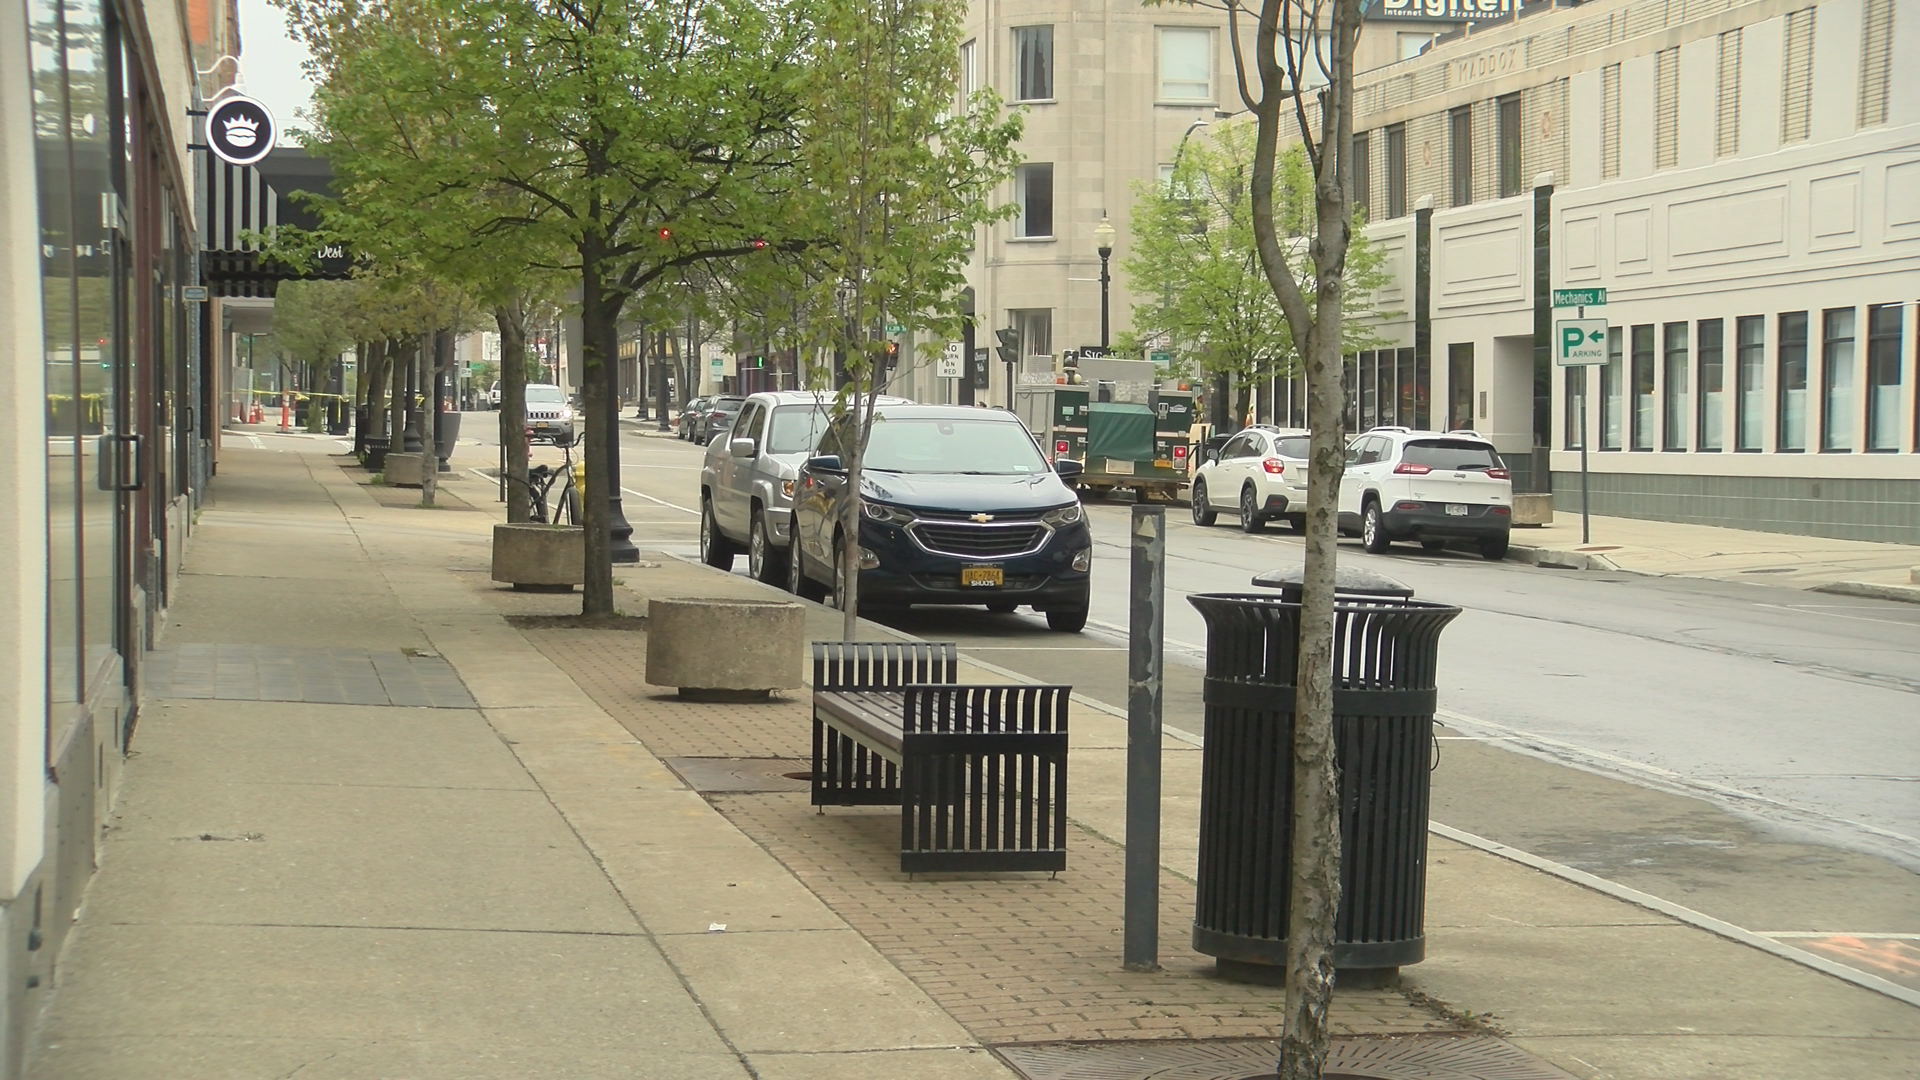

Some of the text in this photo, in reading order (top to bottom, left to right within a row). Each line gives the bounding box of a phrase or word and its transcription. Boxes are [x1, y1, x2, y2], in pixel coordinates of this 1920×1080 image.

[1384, 8, 1422, 16] Internet
[1459, 49, 1515, 82] MADDOX
[1555, 291, 1593, 305] Mechanics
